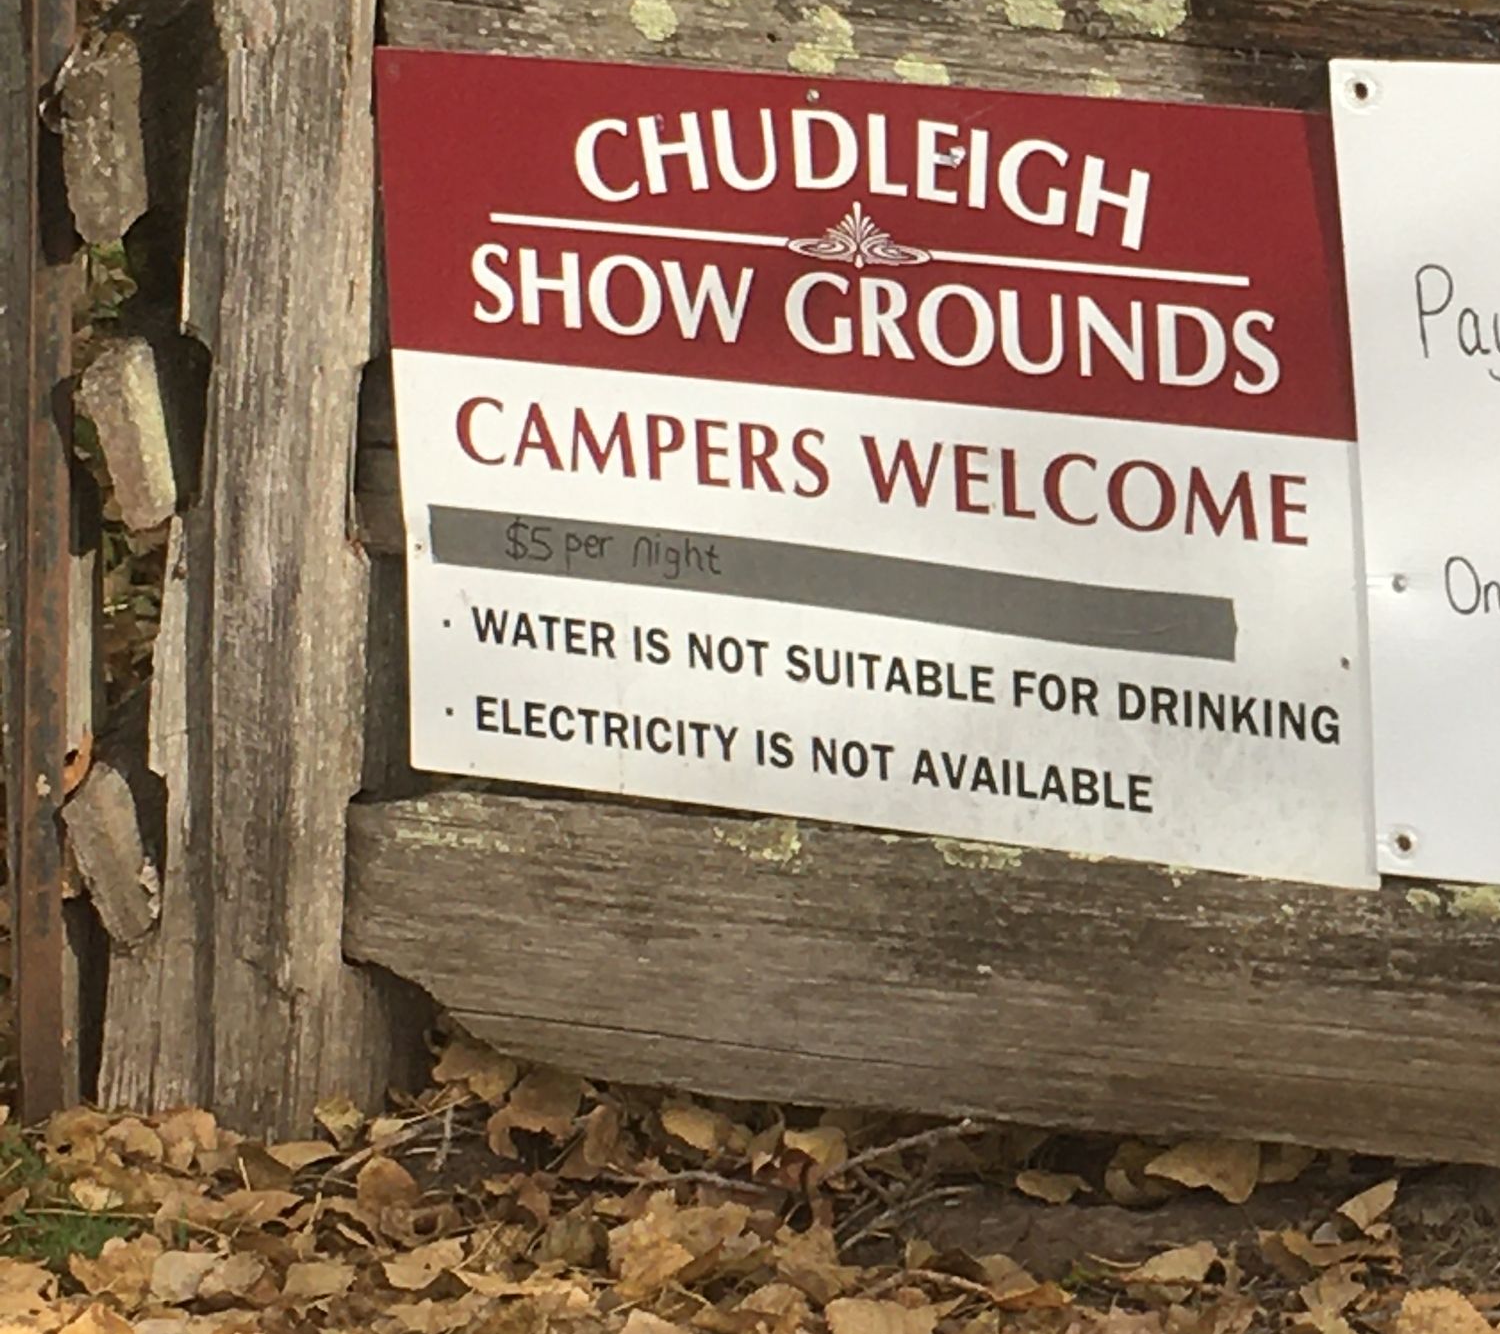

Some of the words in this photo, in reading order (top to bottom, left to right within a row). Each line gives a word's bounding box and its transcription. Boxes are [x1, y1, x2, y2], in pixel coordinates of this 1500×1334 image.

[574, 107, 1150, 252] CHUDLEIGH
[472, 244, 753, 344] SHOW
[785, 270, 1281, 394] GROUNDS
[455, 396, 830, 498] CAMPERS
[859, 434, 1311, 547] WELCOME
[505, 515, 553, 561] $5
[565, 533, 613, 569] per
[631, 534, 722, 579] night
[472, 606, 617, 659] WATER
[632, 625, 670, 665] IS
[687, 633, 769, 677] NOT
[785, 645, 995, 705] SUITABLE
[1011, 670, 1099, 717] FOR
[1117, 681, 1340, 745] DRINKING
[475, 695, 738, 762] ELECTRICITY
[755, 731, 794, 770] IS
[812, 737, 894, 784] NOT
[911, 747, 1154, 813] AVAILABLE
